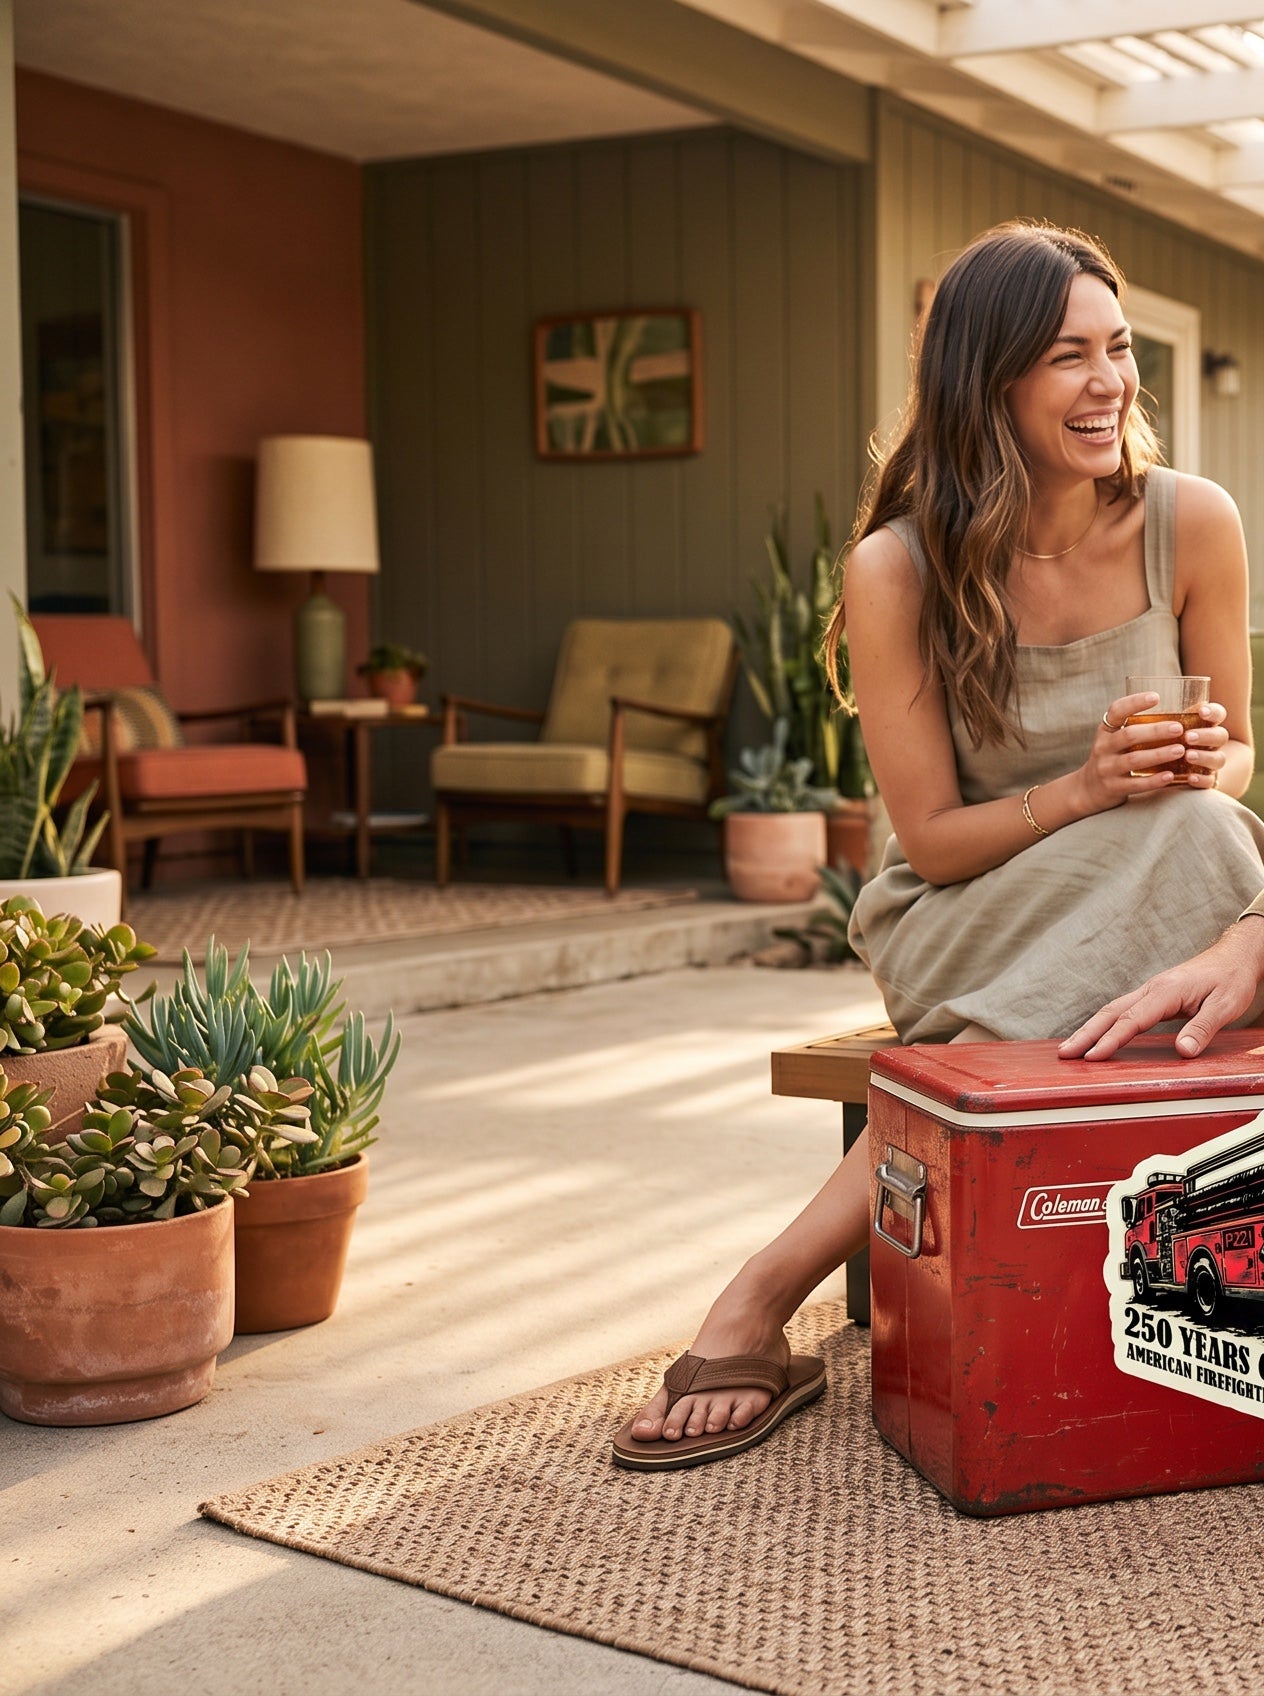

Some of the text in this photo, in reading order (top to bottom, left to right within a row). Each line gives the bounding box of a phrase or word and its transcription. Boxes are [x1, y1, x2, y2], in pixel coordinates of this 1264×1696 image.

[1030, 1192, 1100, 1220] Coleman
[1125, 1307, 1172, 1349] 250
[1178, 1326, 1250, 1375] YEARS
[1126, 1342, 1192, 1379] AMERICAN
